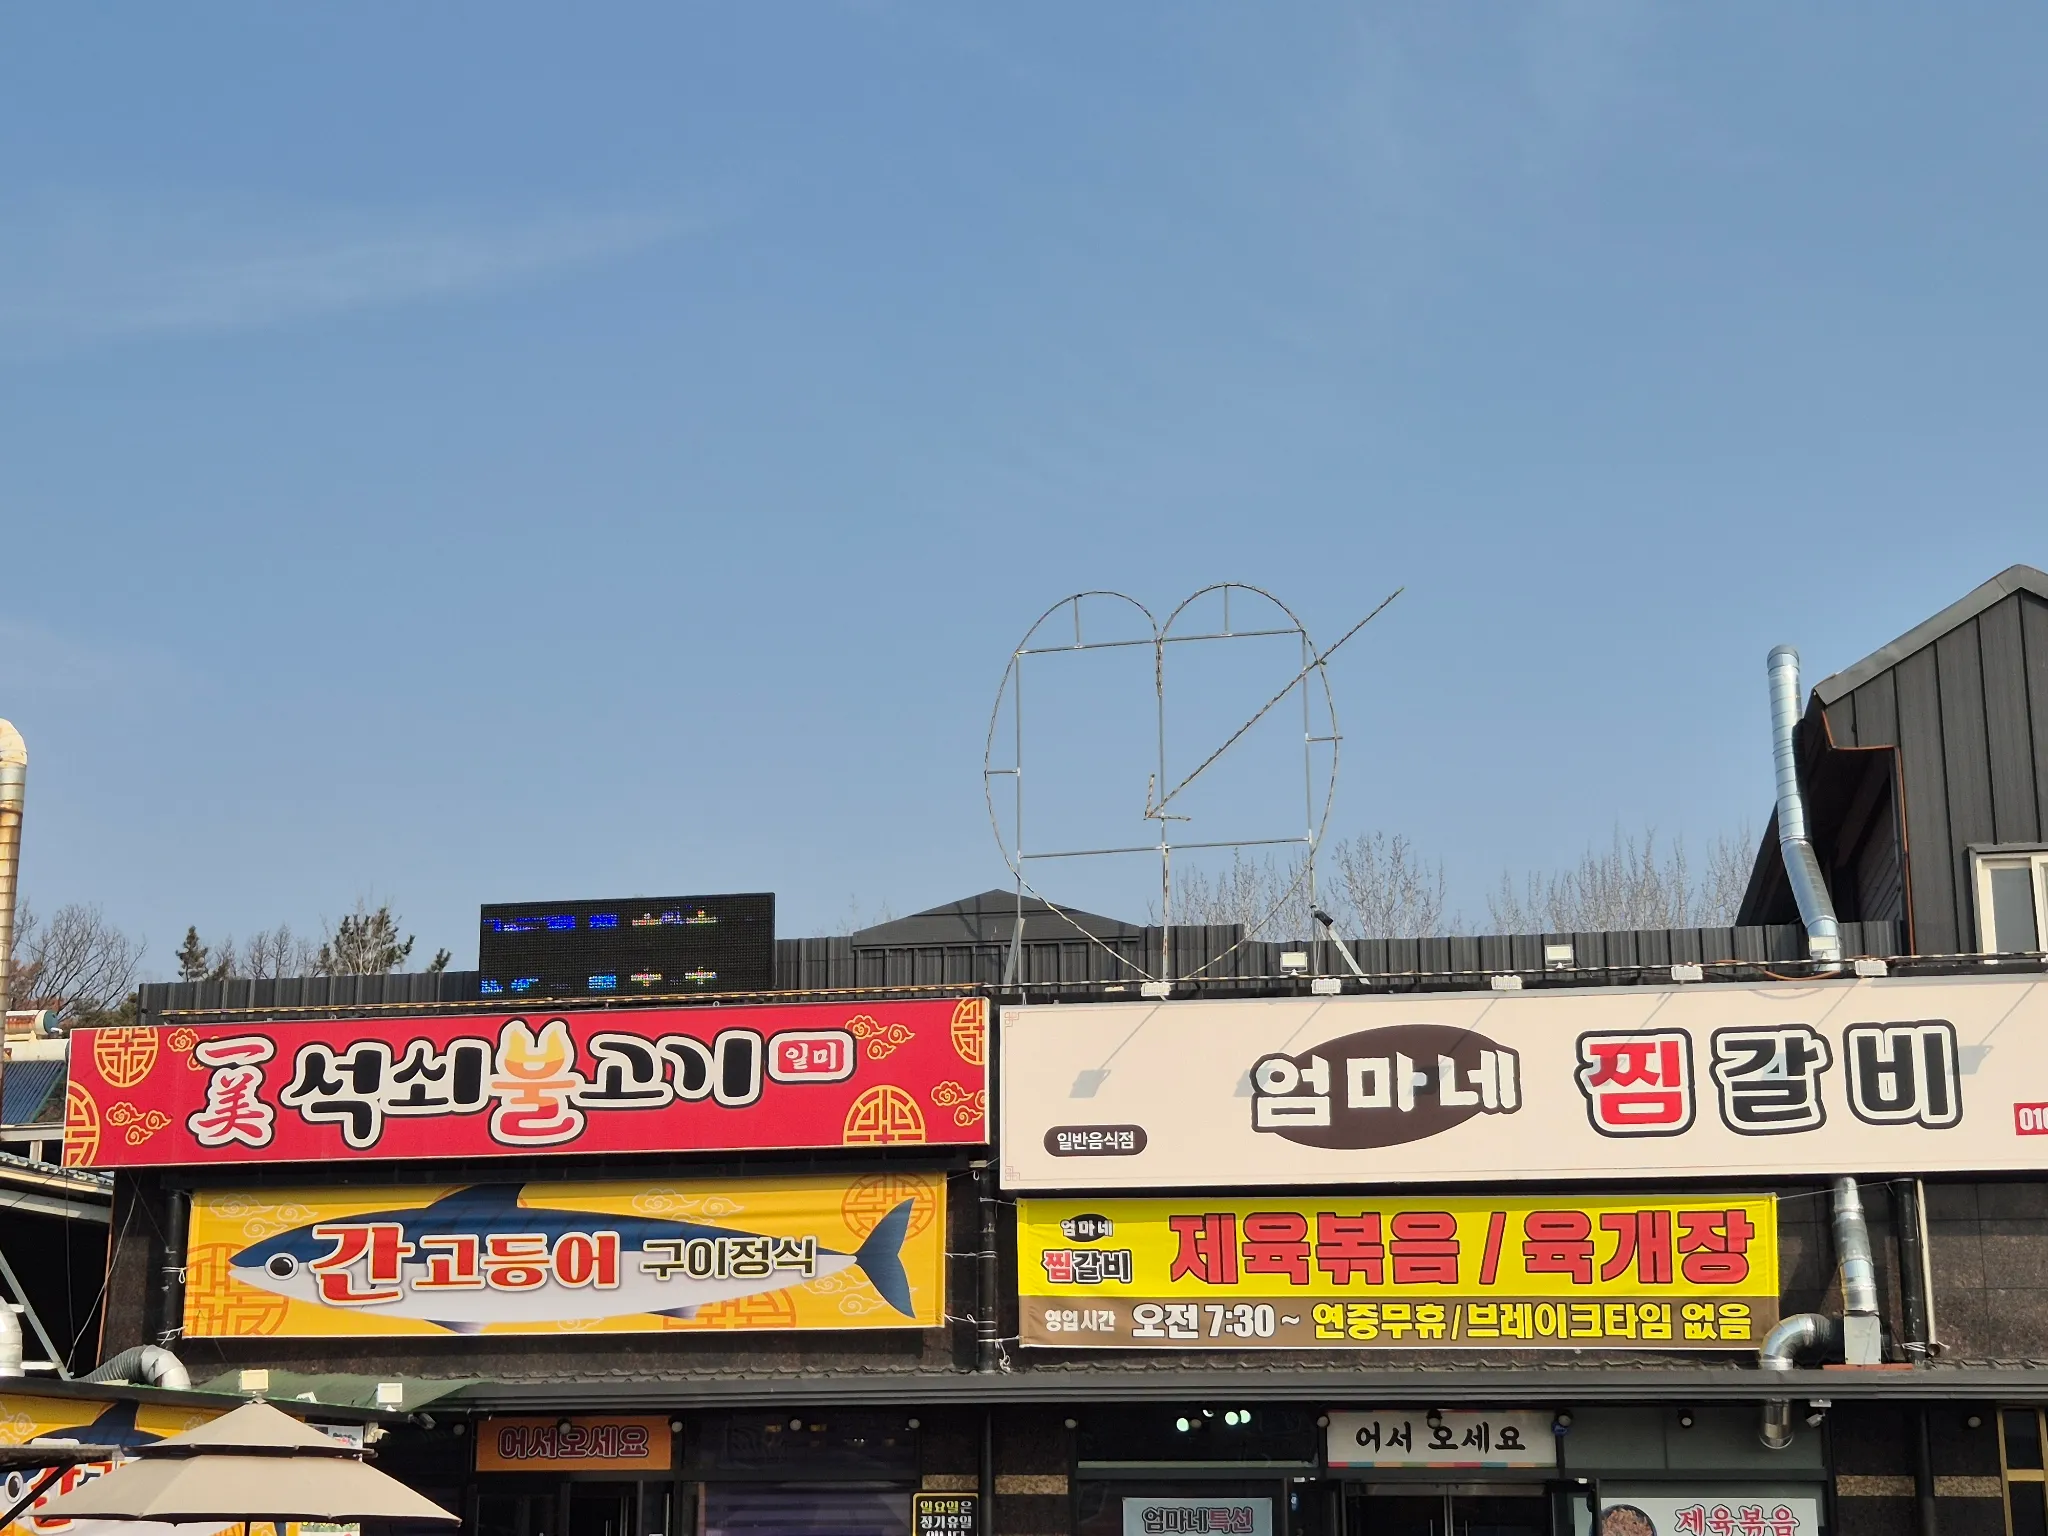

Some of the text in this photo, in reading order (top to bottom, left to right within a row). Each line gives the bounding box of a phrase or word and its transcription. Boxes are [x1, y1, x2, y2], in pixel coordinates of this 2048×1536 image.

[785, 1043, 838, 1071] 일미
[288, 1027, 756, 1144] 석쇠불고기
[1254, 1028, 1952, 1128] 엄마네 찜갈비
[1055, 1129, 1136, 1151] 일반음식점
[1060, 1219, 1114, 1238] 엄마네
[312, 1224, 815, 1303] 간고등어 구이정식
[1168, 1210, 1460, 1286] 제육볶음
[1521, 1209, 1756, 1285] 육개장
[1042, 1249, 1132, 1283] 찜갈비
[1131, 1302, 1199, 1339] 오전
[1203, 1303, 1276, 1338] 7:30
[1682, 1302, 1752, 1341] 없음
[499, 1426, 649, 1459] 어서오세요
[1355, 1420, 1527, 1454] 어서 오세요
[919, 1500, 973, 1514] 일요일은
[919, 1514, 973, 1529] 정기휴일
[1142, 1507, 1254, 1534] 엄마네특선
[1676, 1505, 1799, 1536] 제육볶음
